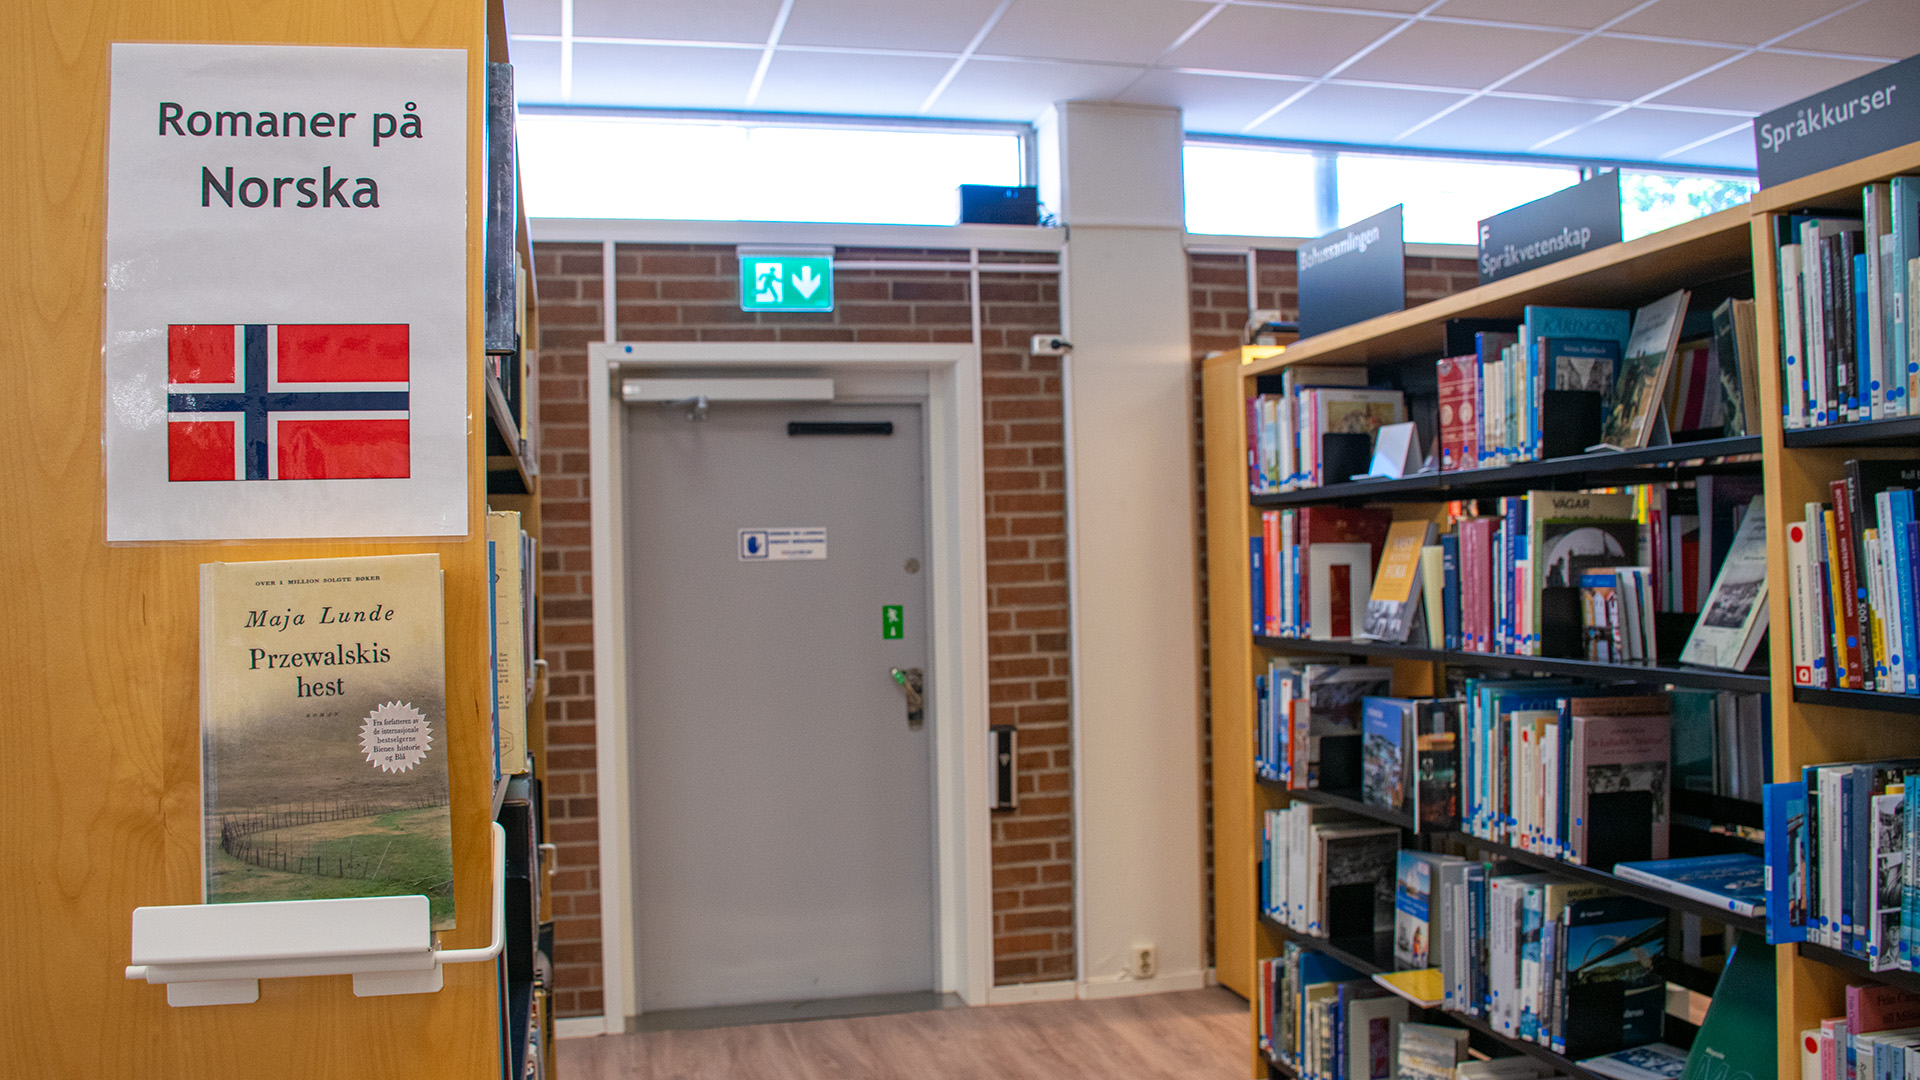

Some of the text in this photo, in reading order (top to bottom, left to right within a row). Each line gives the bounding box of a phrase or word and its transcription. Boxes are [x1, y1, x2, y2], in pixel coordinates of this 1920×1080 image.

[159, 101, 423, 148] Romaner på
[1760, 85, 1897, 154] Språkkurser
[201, 166, 380, 209] Norska
[1300, 226, 1380, 272] Bohussamlingen
[1480, 224, 1490, 250] F
[1481, 226, 1591, 278] Språkvetenskap
[244, 604, 395, 632] Maja Lunde
[248, 642, 391, 670] Przewalskis
[296, 676, 345, 698] hest
[373, 719, 382, 727] Fra
[381, 726, 419, 735] internasjonale
[396, 744, 421, 752] historie
